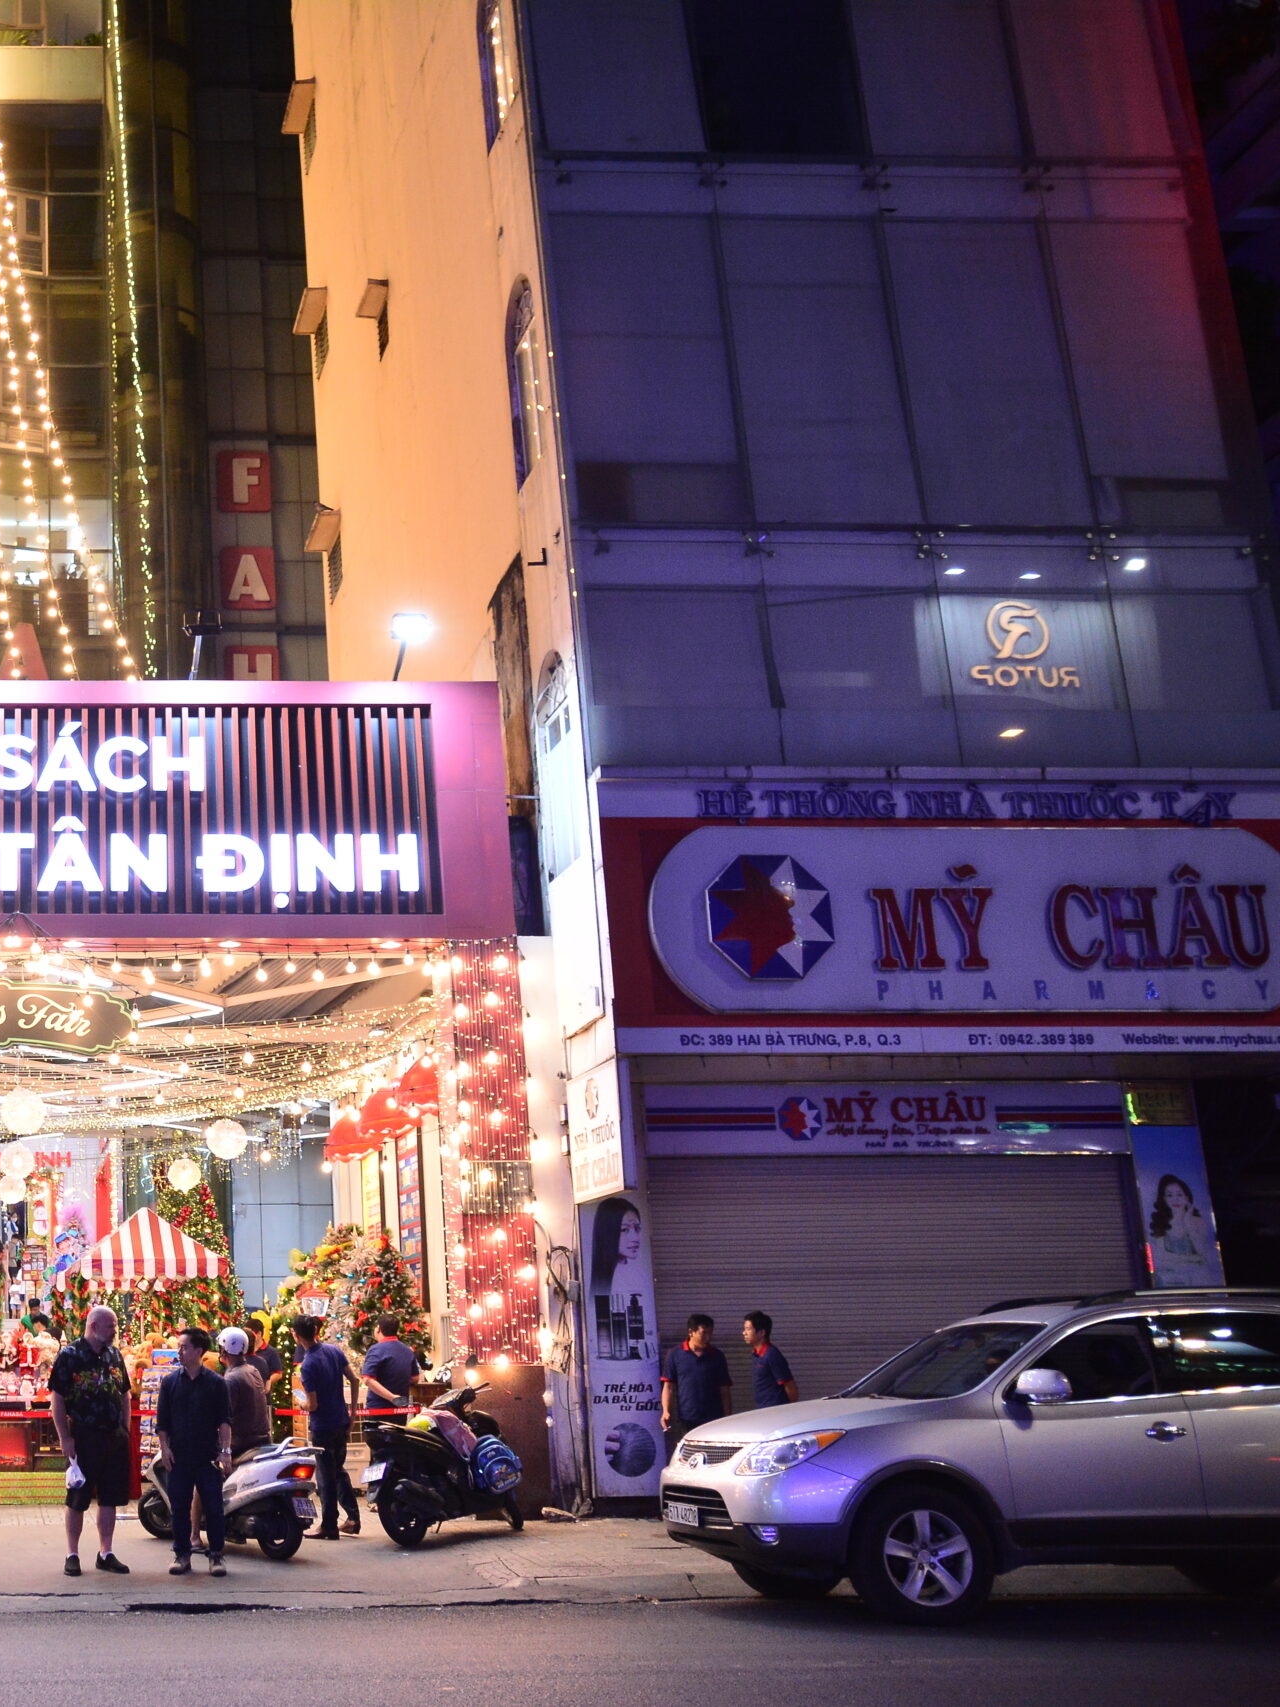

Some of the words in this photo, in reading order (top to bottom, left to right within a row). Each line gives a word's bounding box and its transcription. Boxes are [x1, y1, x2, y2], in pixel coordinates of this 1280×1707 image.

[698, 787, 756, 825] HỆ
[762, 785, 898, 819] THỐNG
[909, 786, 991, 819] NHÀ
[1002, 785, 1143, 820] THUỐC
[195, 832, 420, 910] ĐỊNH
[869, 863, 993, 972] MỸ
[1050, 863, 1271, 972] CHÂU
[877, 979, 1269, 1002] PHARMACY
[16, 993, 91, 1037] Fair
[679, 1033, 705, 1047] ĐC:
[708, 1033, 734, 1047] 389
[737, 1033, 761, 1047] HAI
[765, 1031, 785, 1047] BÀ
[788, 1032, 841, 1049] TRƯNG,
[844, 1033, 872, 1048] P.8,
[877, 1033, 902, 1047] Q.3
[968, 1032, 993, 1046] ĐT:
[1122, 1033, 1180, 1046] Website:
[823, 1090, 879, 1123] MỸ
[890, 1091, 986, 1123] CHÂU
[593, 1395, 609, 1404] DA
[604, 1381, 626, 1393] TRẺ
[628, 1381, 654, 1393] HÓA
